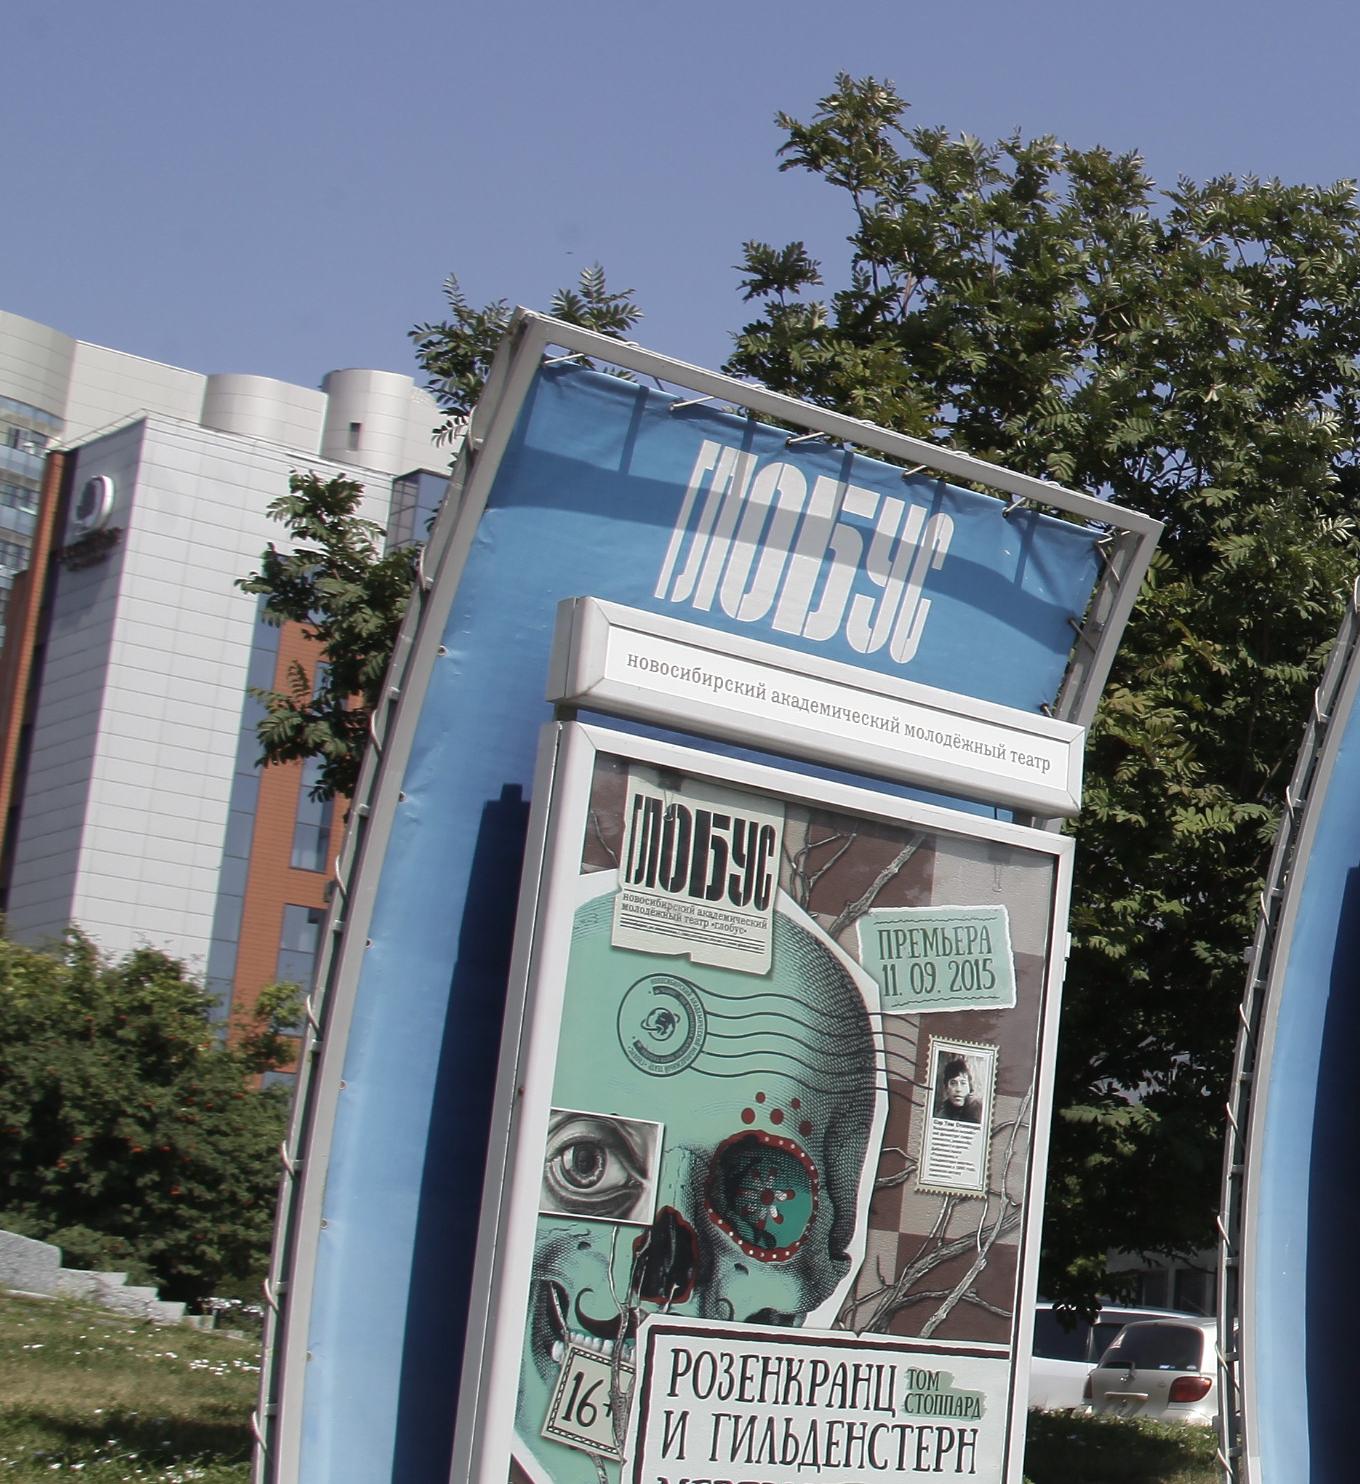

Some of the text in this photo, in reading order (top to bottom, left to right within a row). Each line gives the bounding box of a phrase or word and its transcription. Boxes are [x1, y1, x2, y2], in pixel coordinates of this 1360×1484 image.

[654, 440, 954, 663] ГЛОБУС
[627, 652, 1051, 773] новосибирский академический молодёжный театр
[625, 793, 776, 911] ГЛОБУС
[684, 916, 709, 930] театр
[878, 925, 993, 960] ПРЕМЬЕРА
[882, 958, 997, 997] 11. 09. 2015
[666, 1348, 898, 1418] РОЗЕНКРАНЦ
[904, 1392, 982, 1419] СТОППАРД
[906, 1368, 940, 1391] ТОМ
[661, 1409, 979, 1475] И ГИЛЬДЕНСТЕРН
